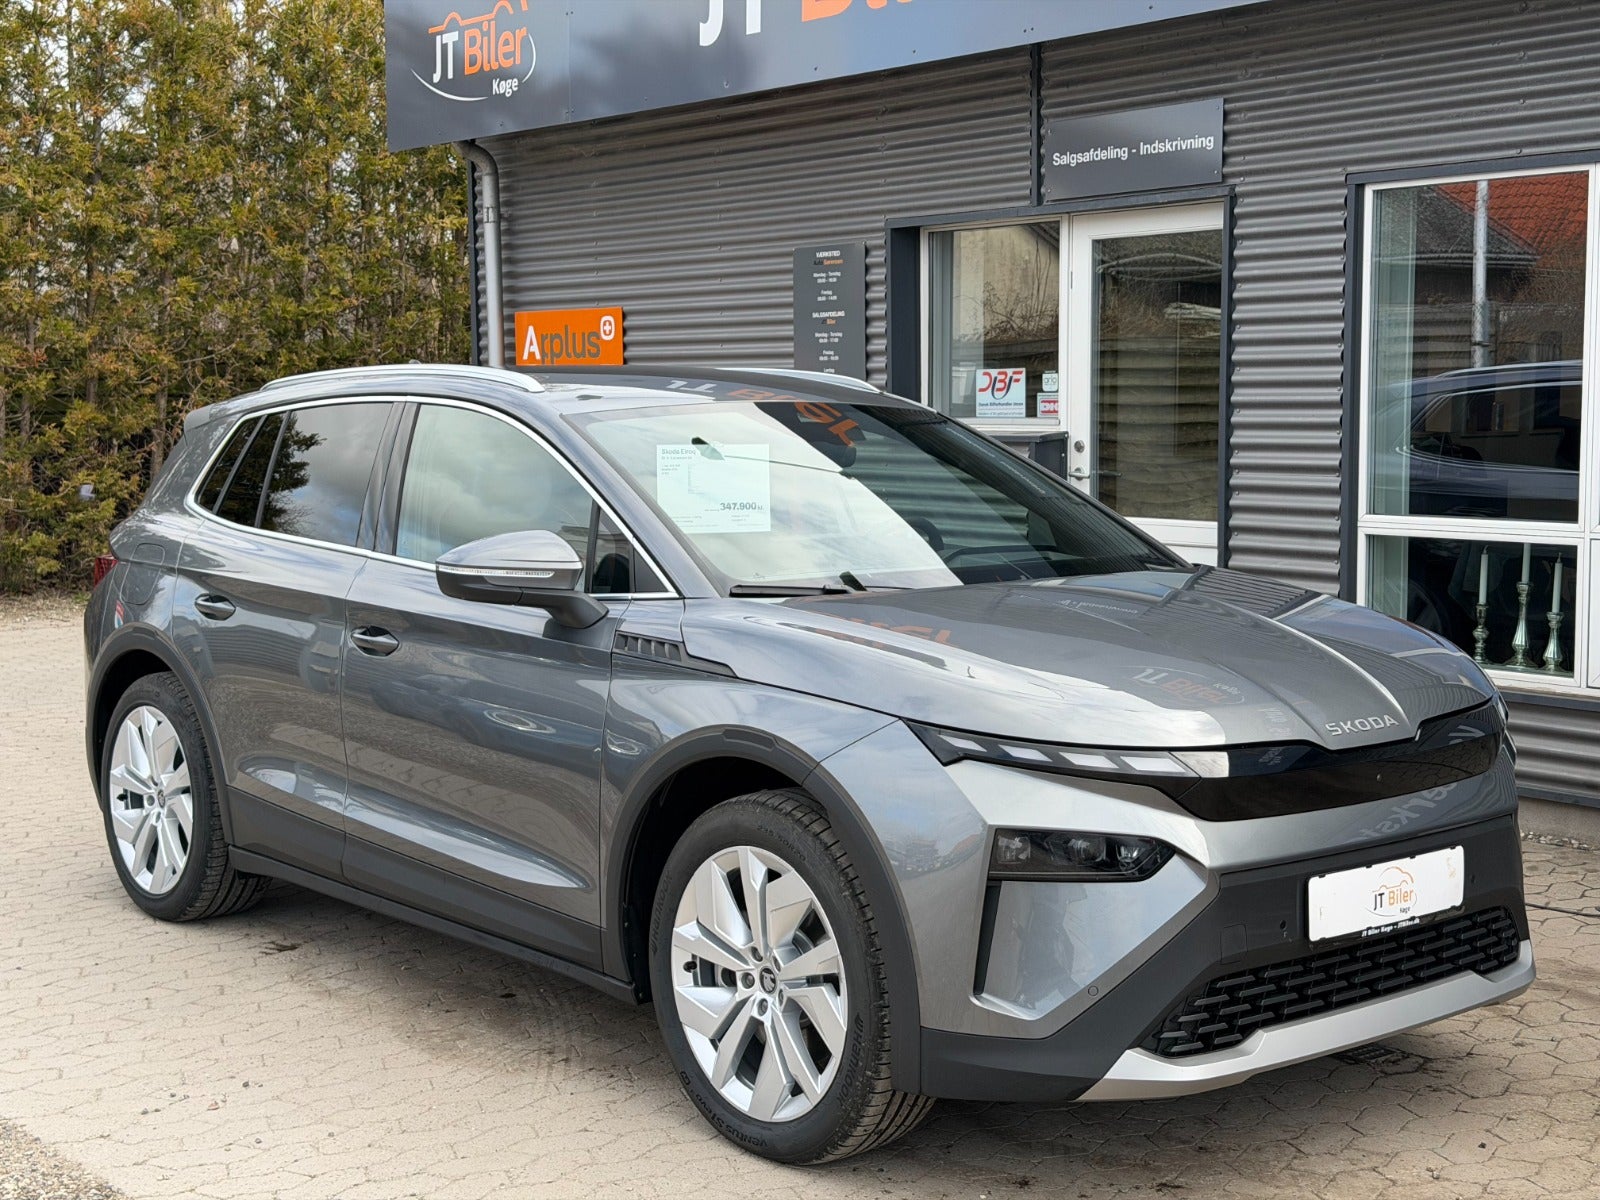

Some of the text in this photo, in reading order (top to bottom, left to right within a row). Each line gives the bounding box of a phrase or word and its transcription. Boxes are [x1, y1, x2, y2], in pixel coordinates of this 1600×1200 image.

[432, 20, 527, 83] JT Biler
[492, 77, 519, 97] Køge
[1052, 145, 1128, 167] Salgsafdeling
[1139, 134, 1215, 156] Indskrivning
[1325, 714, 1399, 736] SKODA
[1374, 888, 1413, 911] JT Biler
